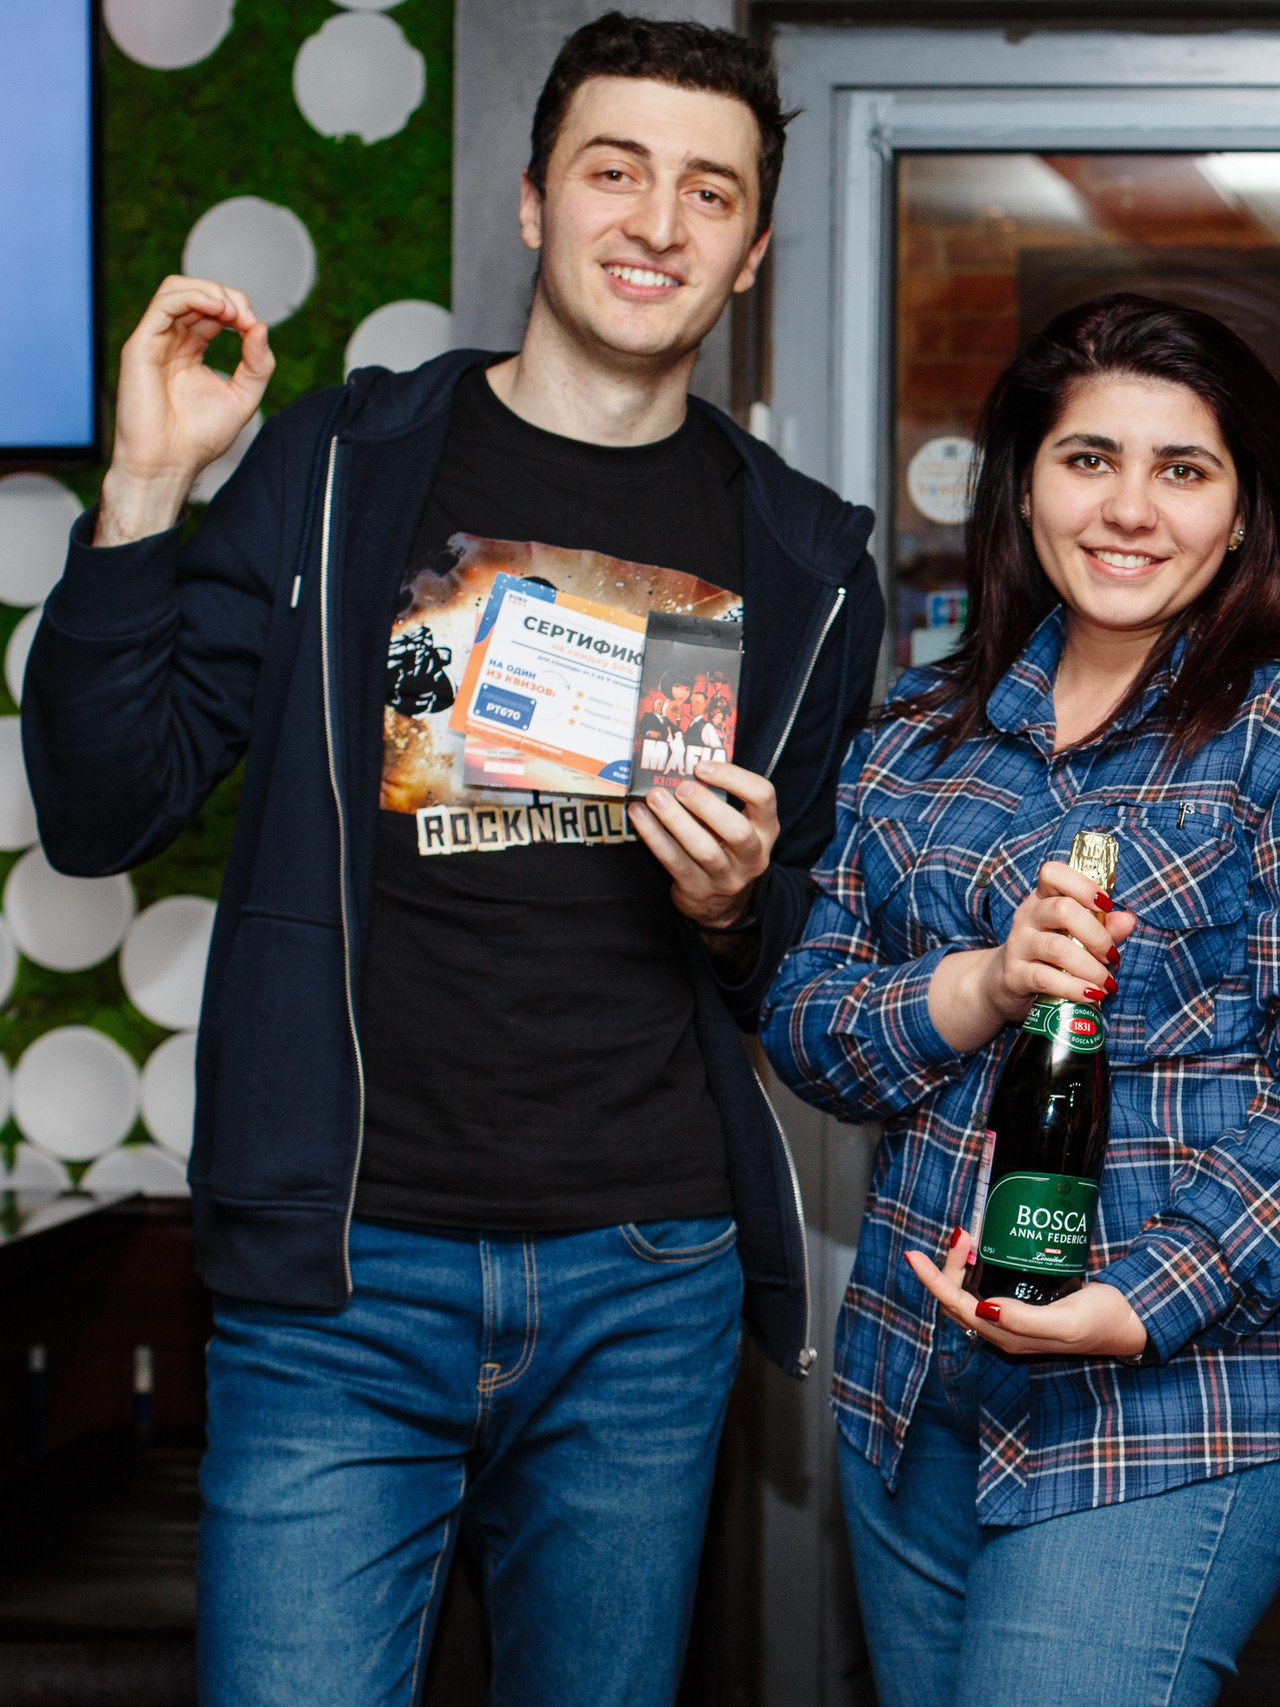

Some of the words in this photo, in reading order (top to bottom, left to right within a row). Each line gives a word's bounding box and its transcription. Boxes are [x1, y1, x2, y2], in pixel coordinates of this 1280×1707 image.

[489, 658, 503, 669] НА
[507, 664, 536, 680] ОДИН
[551, 643, 564, 653] на
[567, 648, 608, 668] скидку
[612, 661, 635, 676] 50%
[486, 668, 501, 680] ИЗ
[505, 674, 556, 698] КВИЗОВ:
[1074, 1021, 1091, 1032] 1831
[1072, 1037, 1090, 1045] BOSCA
[1016, 1204, 1087, 1232] BOSCA
[1009, 1226, 1043, 1241] ANNA
[1047, 1232, 1088, 1245] FEDERICA
[1032, 1251, 1068, 1264] Limited
